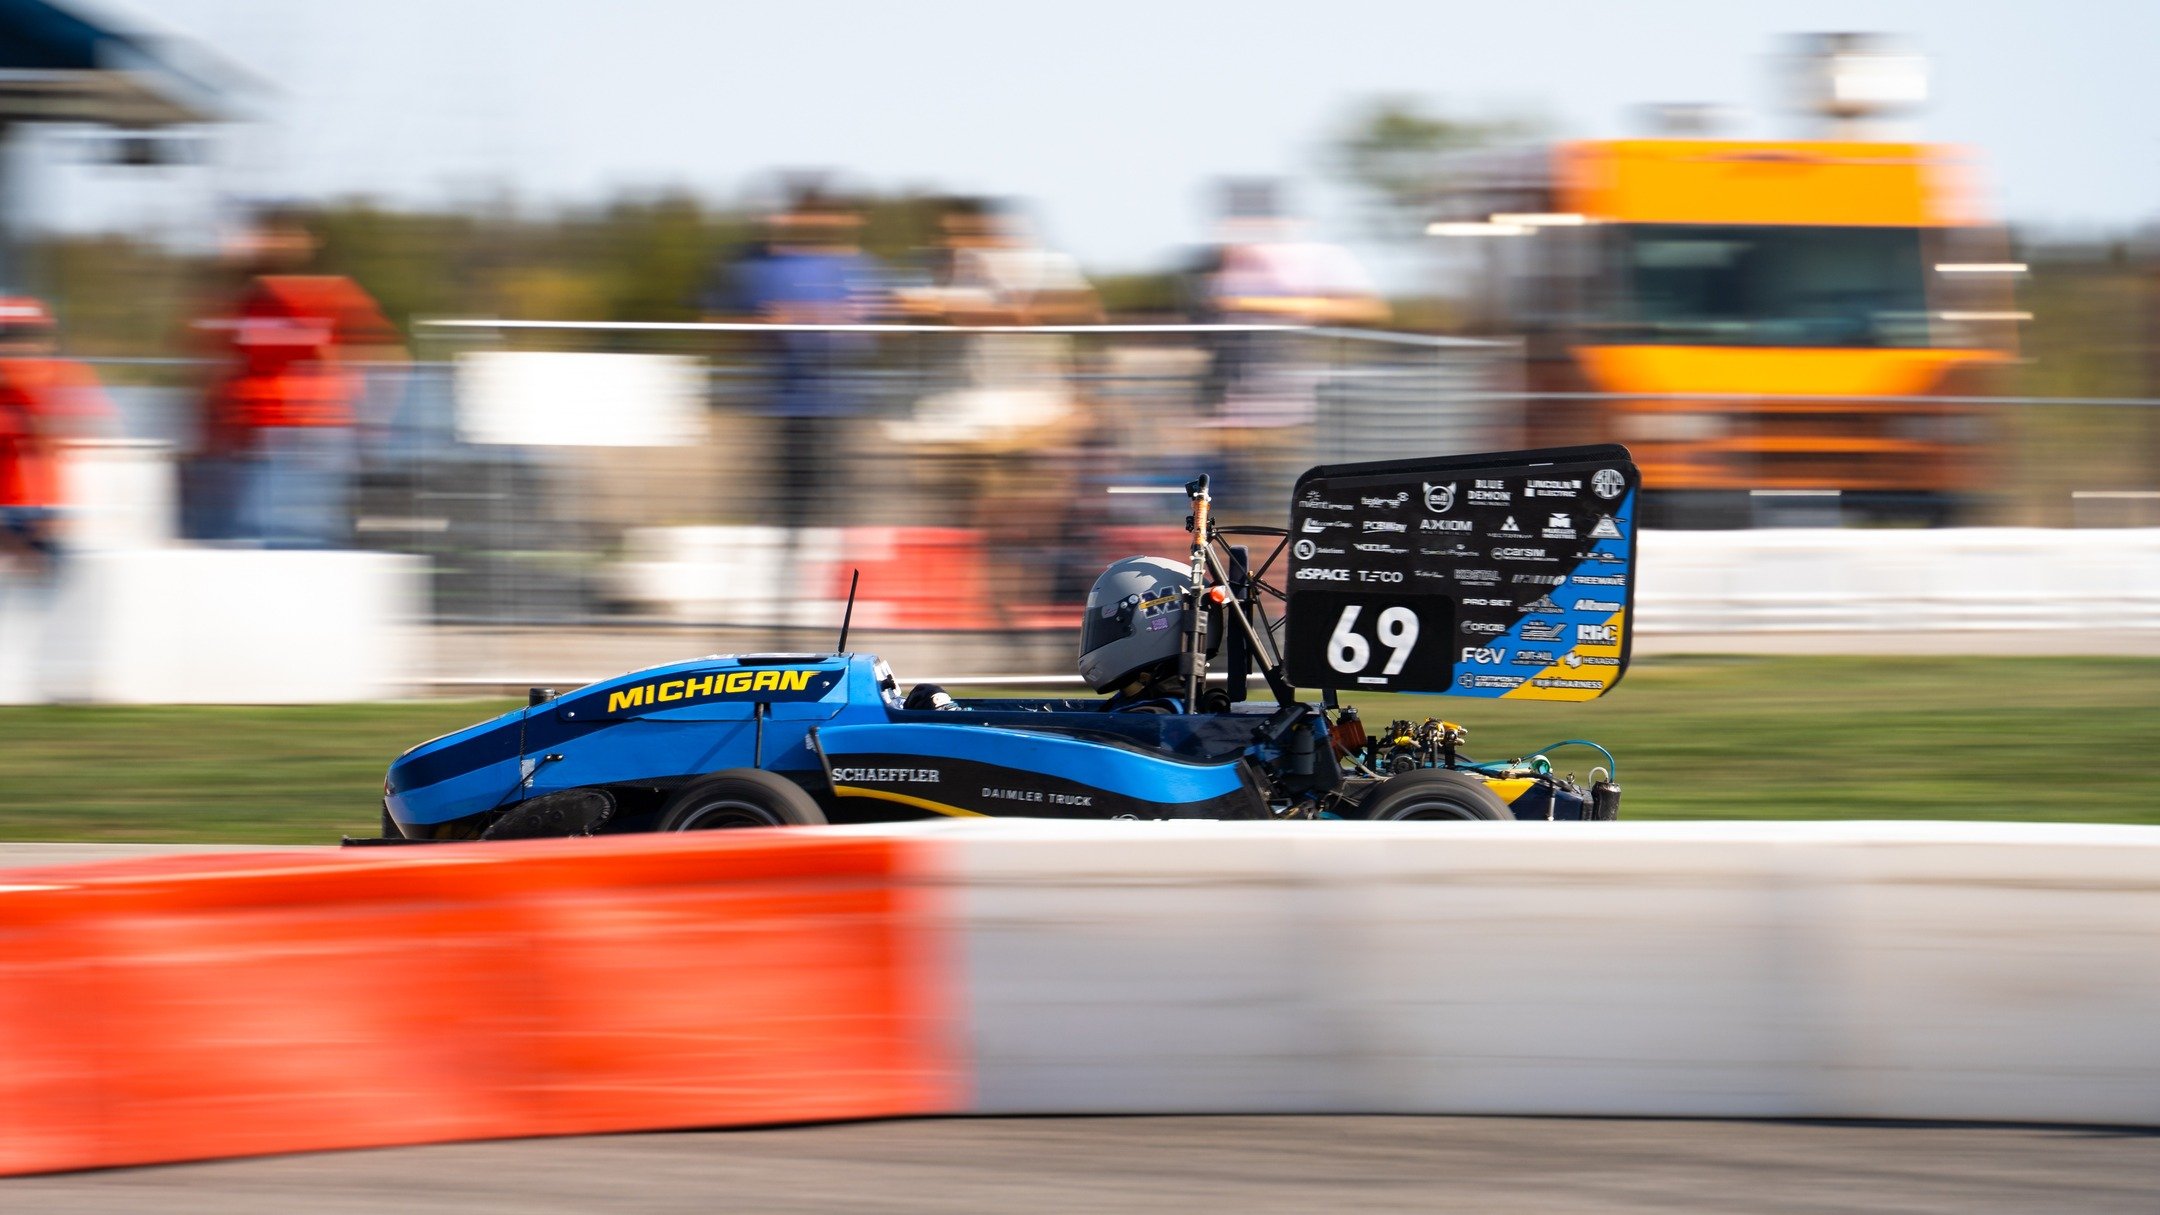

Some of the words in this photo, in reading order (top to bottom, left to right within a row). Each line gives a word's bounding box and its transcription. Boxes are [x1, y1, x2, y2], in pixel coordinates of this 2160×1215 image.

[1475, 480, 1504, 489] BLUE
[1527, 480, 1572, 489] LINCOLN
[1467, 491, 1511, 500] DEMON
[1419, 519, 1473, 531] AXIOM
[1295, 567, 1350, 580] dSPACE
[1462, 598, 1513, 607] PRO-SET
[1577, 624, 1617, 640] RBC
[1327, 605, 1420, 675] 69
[608, 670, 822, 712] MICHIGAN
[832, 767, 940, 783] SCHAEFFLER
[981, 787, 1043, 803] DAIMLER
[1048, 793, 1092, 807] TRUCK
